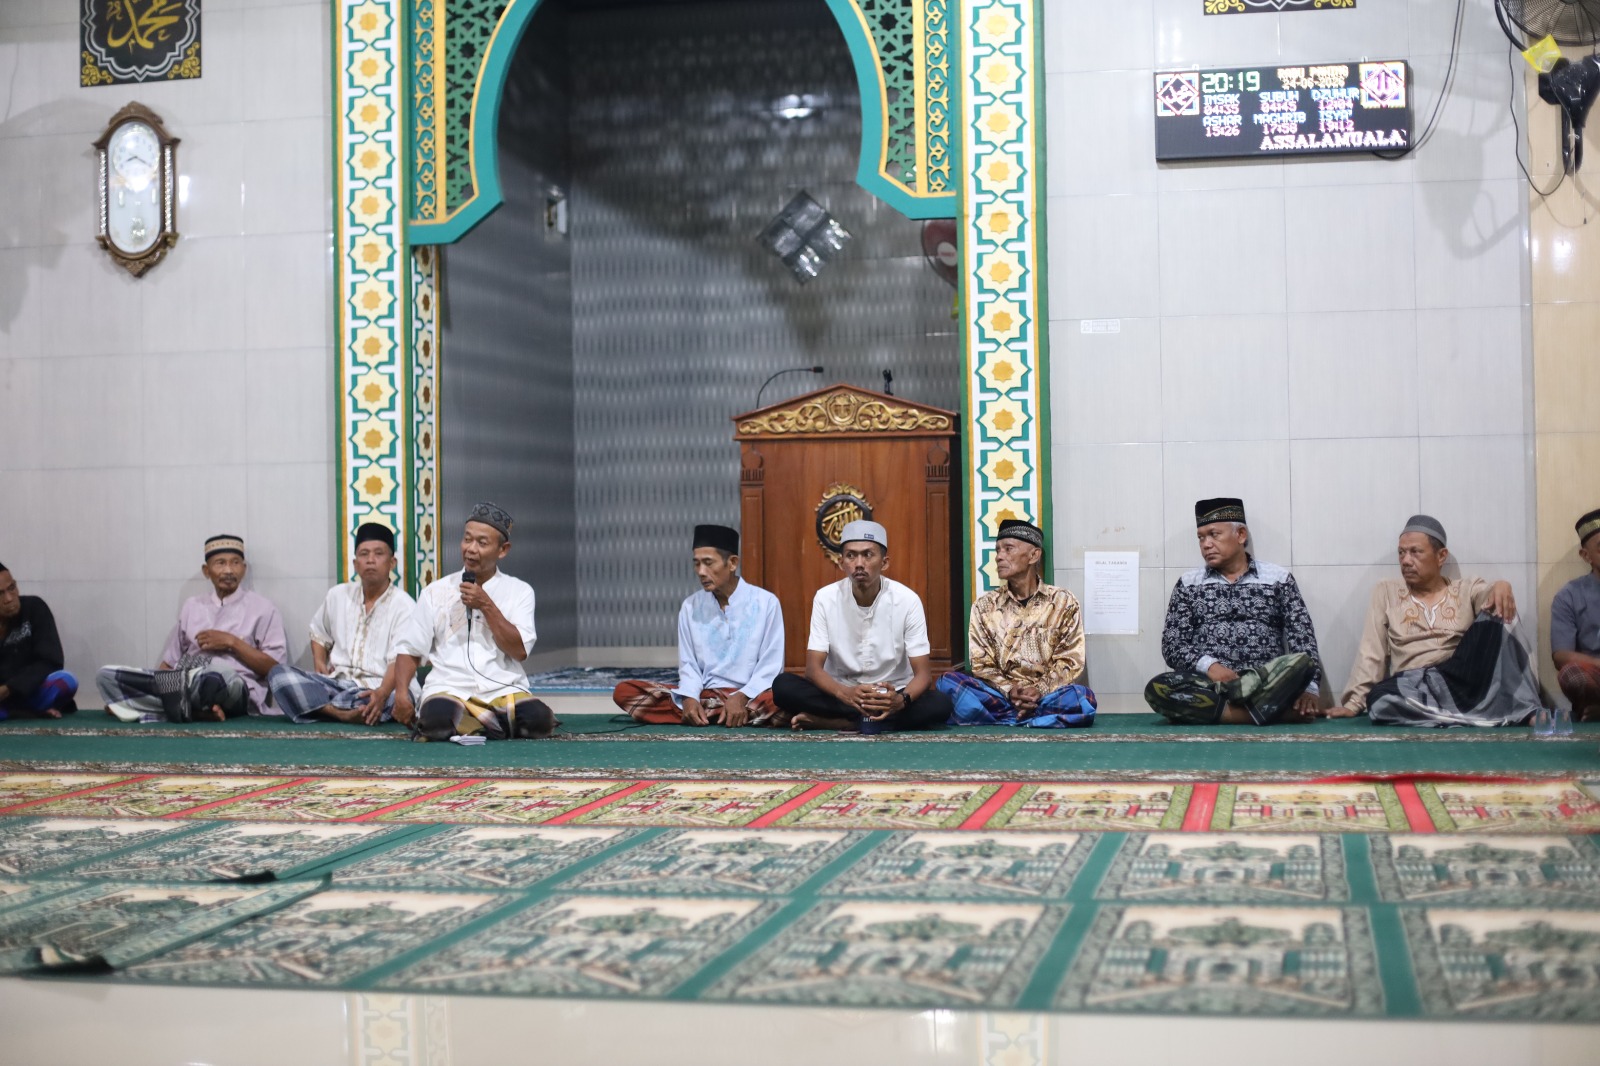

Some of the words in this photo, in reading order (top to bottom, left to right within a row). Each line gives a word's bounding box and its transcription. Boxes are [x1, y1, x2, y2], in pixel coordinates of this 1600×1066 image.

[1202, 71, 1260, 93] 20:19
[1203, 94, 1240, 105] IMSAK
[1259, 91, 1299, 103] SUBUH
[1310, 87, 1359, 101] DZUHUR
[1203, 104, 1239, 115] 04:35
[1260, 101, 1297, 113] 04:45
[1203, 115, 1242, 127] ASHAR
[1253, 112, 1306, 124] MAGHRIB
[1205, 125, 1240, 137] 15:26
[1263, 122, 1298, 134] 17:58
[1319, 120, 1354, 132] 19:12
